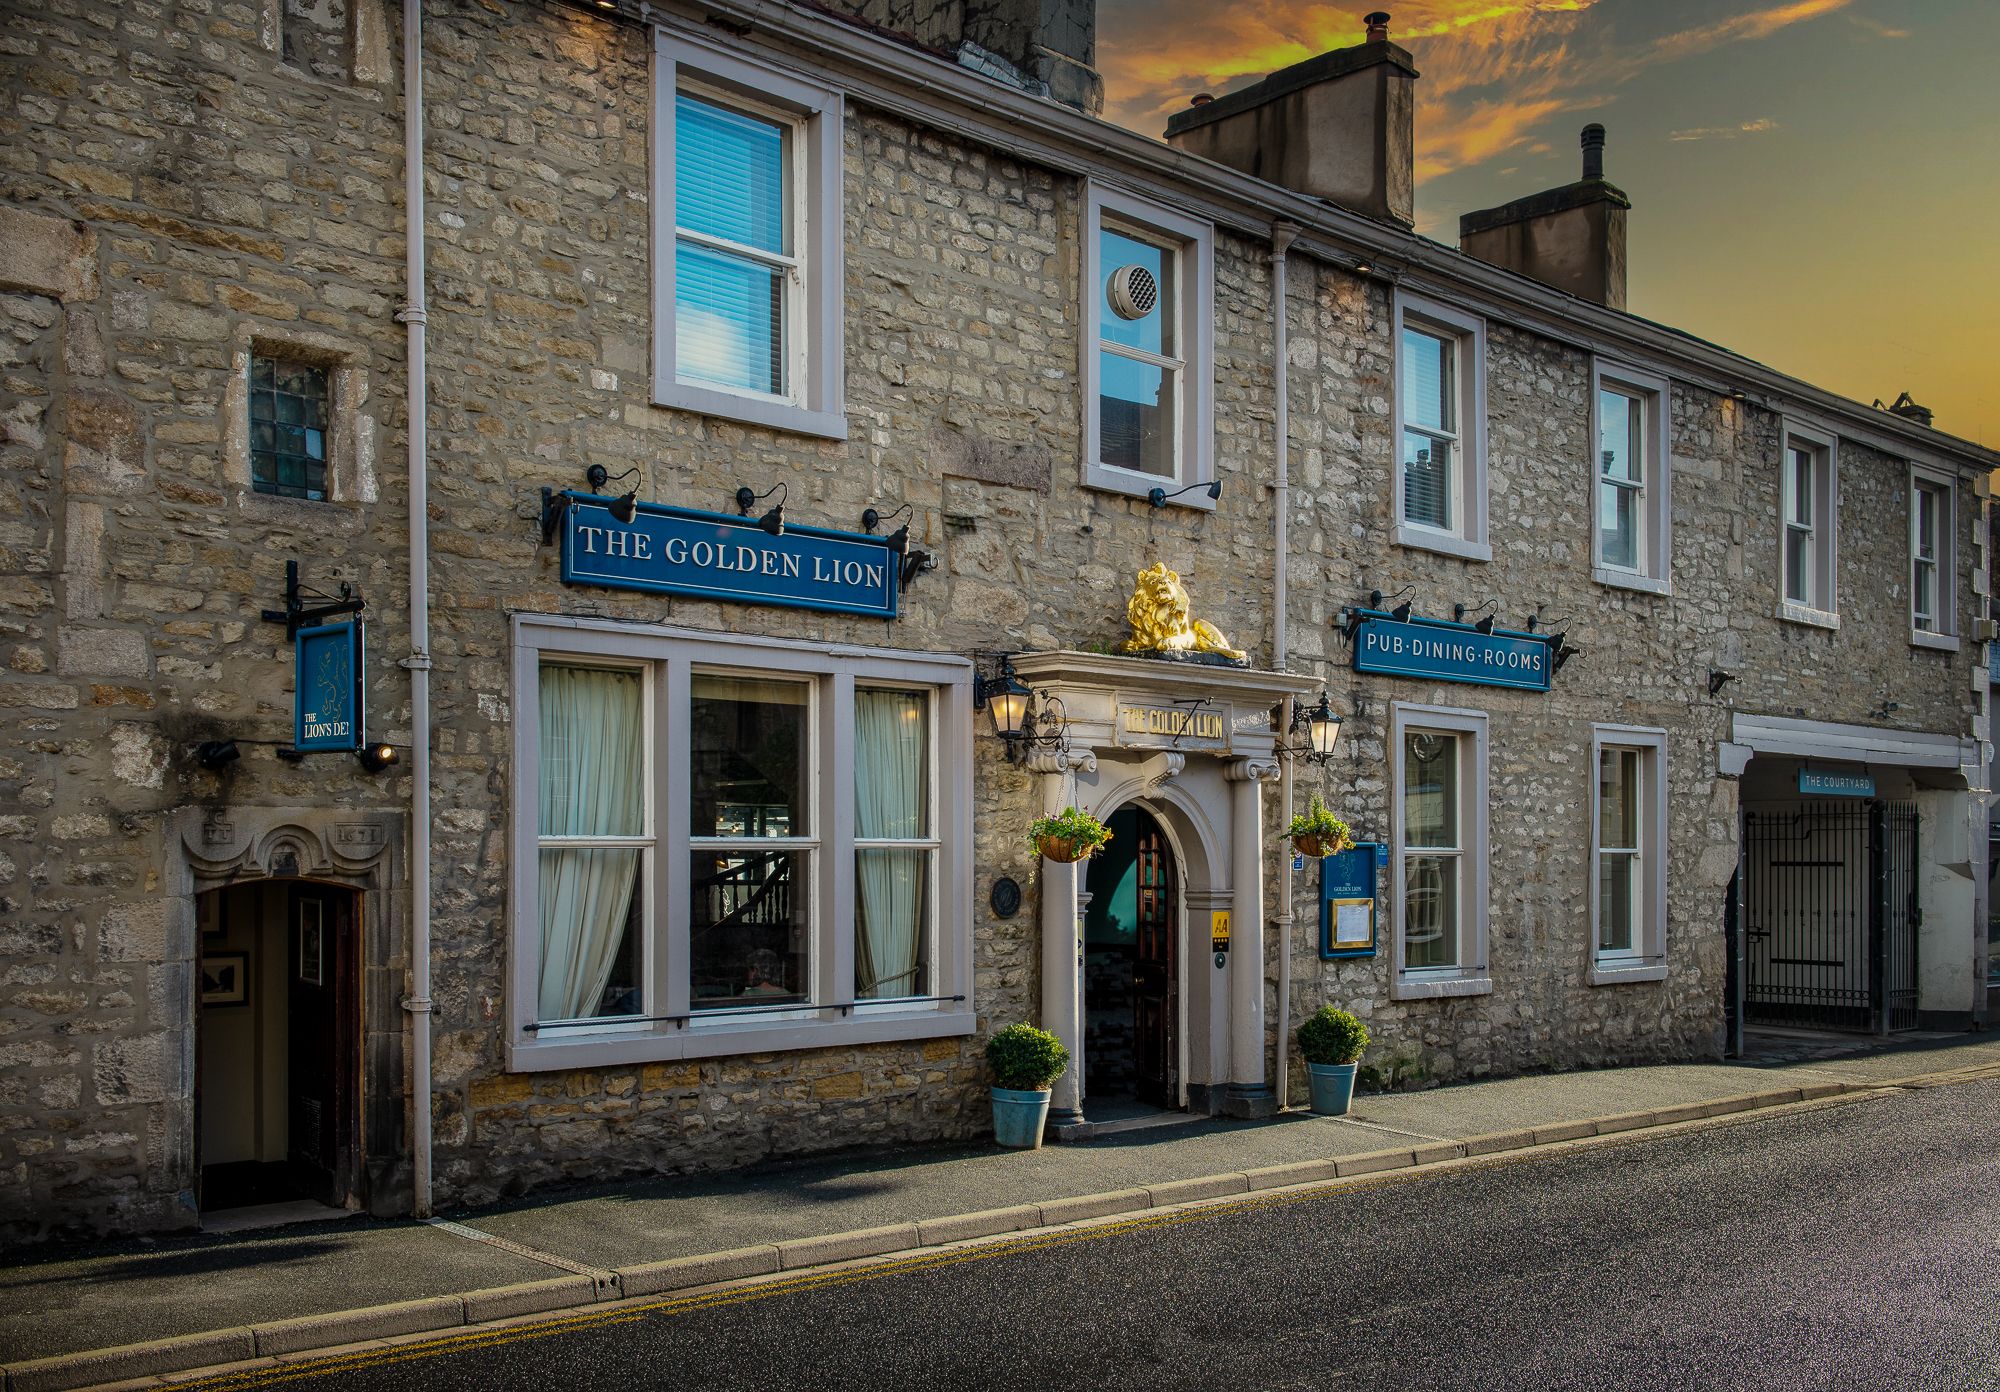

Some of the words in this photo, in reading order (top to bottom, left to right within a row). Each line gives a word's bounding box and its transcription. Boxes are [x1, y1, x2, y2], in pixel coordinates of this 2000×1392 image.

[578, 525, 652, 560] THE
[665, 537, 802, 578] GOLDEN
[813, 555, 884, 588] LION
[304, 713, 317, 722] THE
[1123, 708, 1146, 733] THE
[1149, 709, 1195, 736] GOLDEN
[1196, 714, 1223, 738] LION
[304, 722, 332, 739] LION'S
[1806, 775, 1821, 787] THE
[1823, 776, 1870, 790] COURTYARD
[1215, 919, 1228, 933] AA
